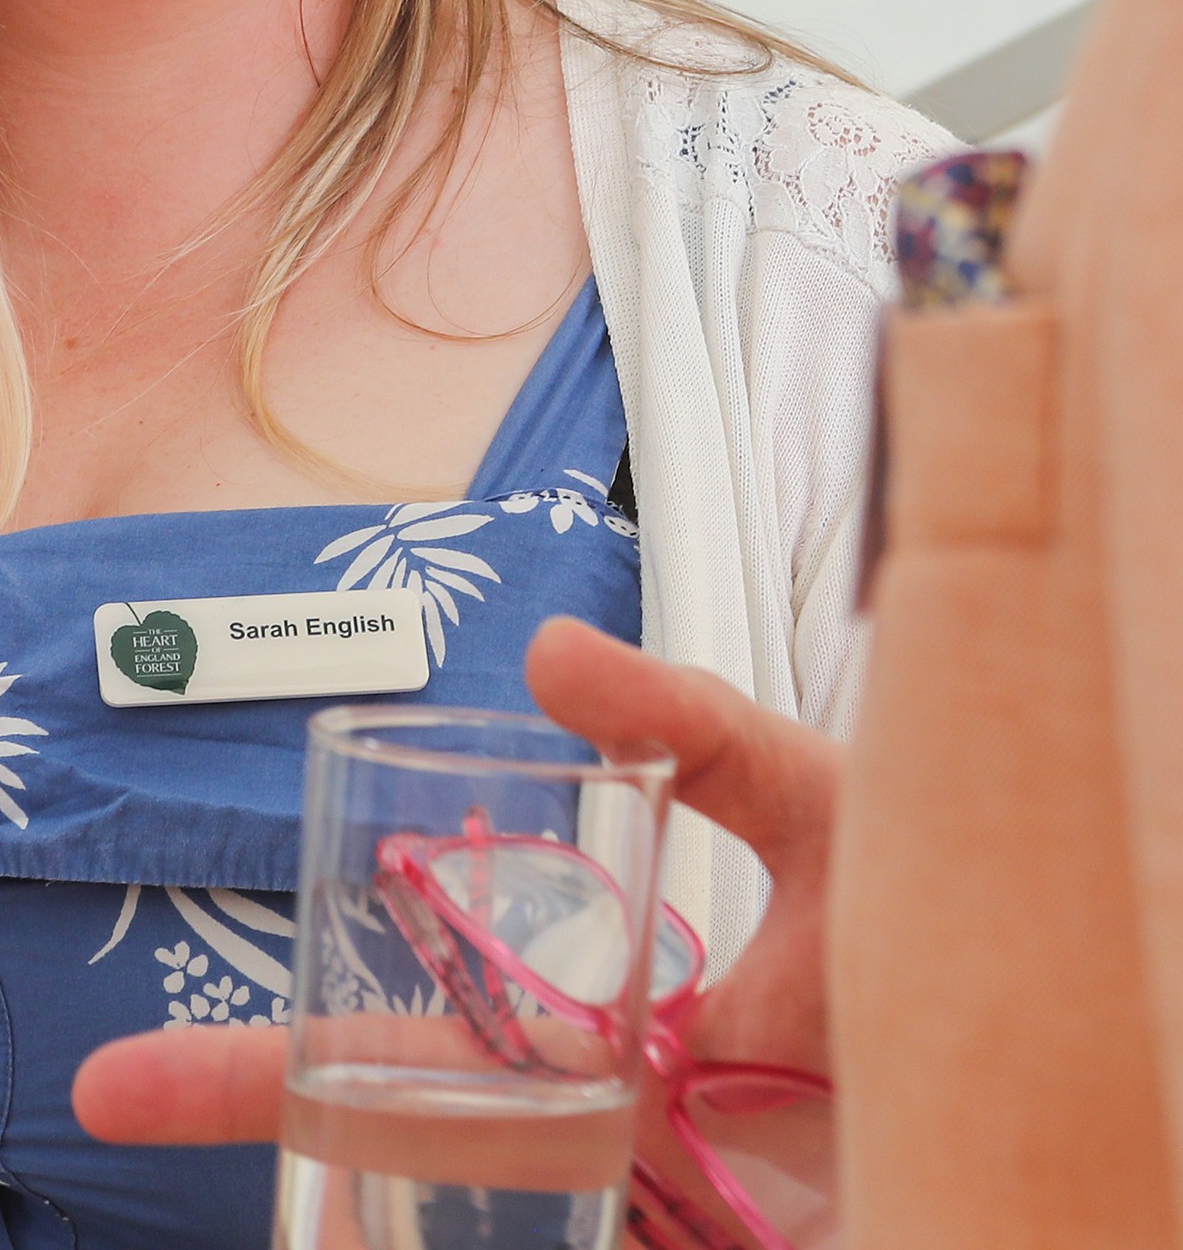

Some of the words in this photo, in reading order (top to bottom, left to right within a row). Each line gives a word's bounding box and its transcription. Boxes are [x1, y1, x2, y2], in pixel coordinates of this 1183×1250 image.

[229, 620, 298, 640] Sarah
[306, 615, 395, 639] English
[132, 634, 178, 648] HEART
[134, 653, 181, 663] ENGLAND
[135, 662, 181, 674] FOREST
